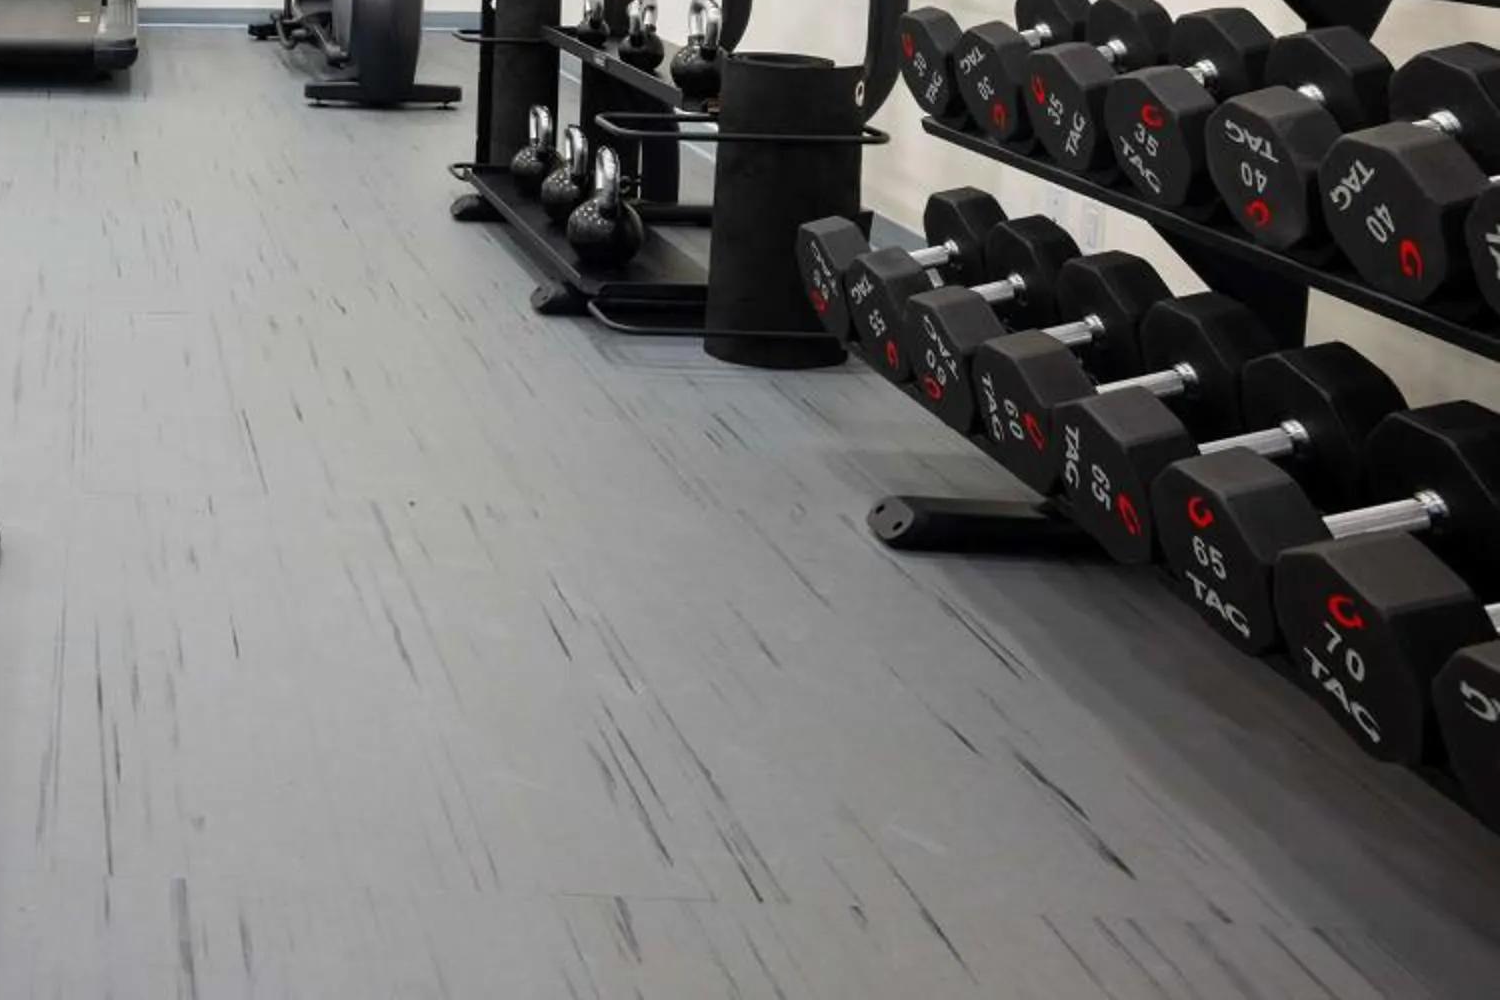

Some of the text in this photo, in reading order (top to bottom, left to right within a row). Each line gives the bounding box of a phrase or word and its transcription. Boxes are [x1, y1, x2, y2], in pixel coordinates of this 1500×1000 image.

[959, 45, 986, 75] TAG
[1064, 111, 1086, 157] TAG
[1133, 121, 1160, 158] 35
[1224, 119, 1280, 164] TAG
[1119, 135, 1162, 195] TAG
[1240, 161, 1268, 194] 40
[1329, 159, 1376, 212] TAG
[1365, 203, 1396, 244] 40
[923, 314, 960, 381] TAG
[981, 372, 1005, 442] TAG
[1003, 398, 1025, 441] 60
[1064, 423, 1080, 489] TAG
[1090, 463, 1112, 512] 65
[1192, 535, 1227, 580] 65
[1185, 569, 1251, 639] TAG
[1323, 621, 1366, 683] 70
[1303, 646, 1382, 744] TAG
